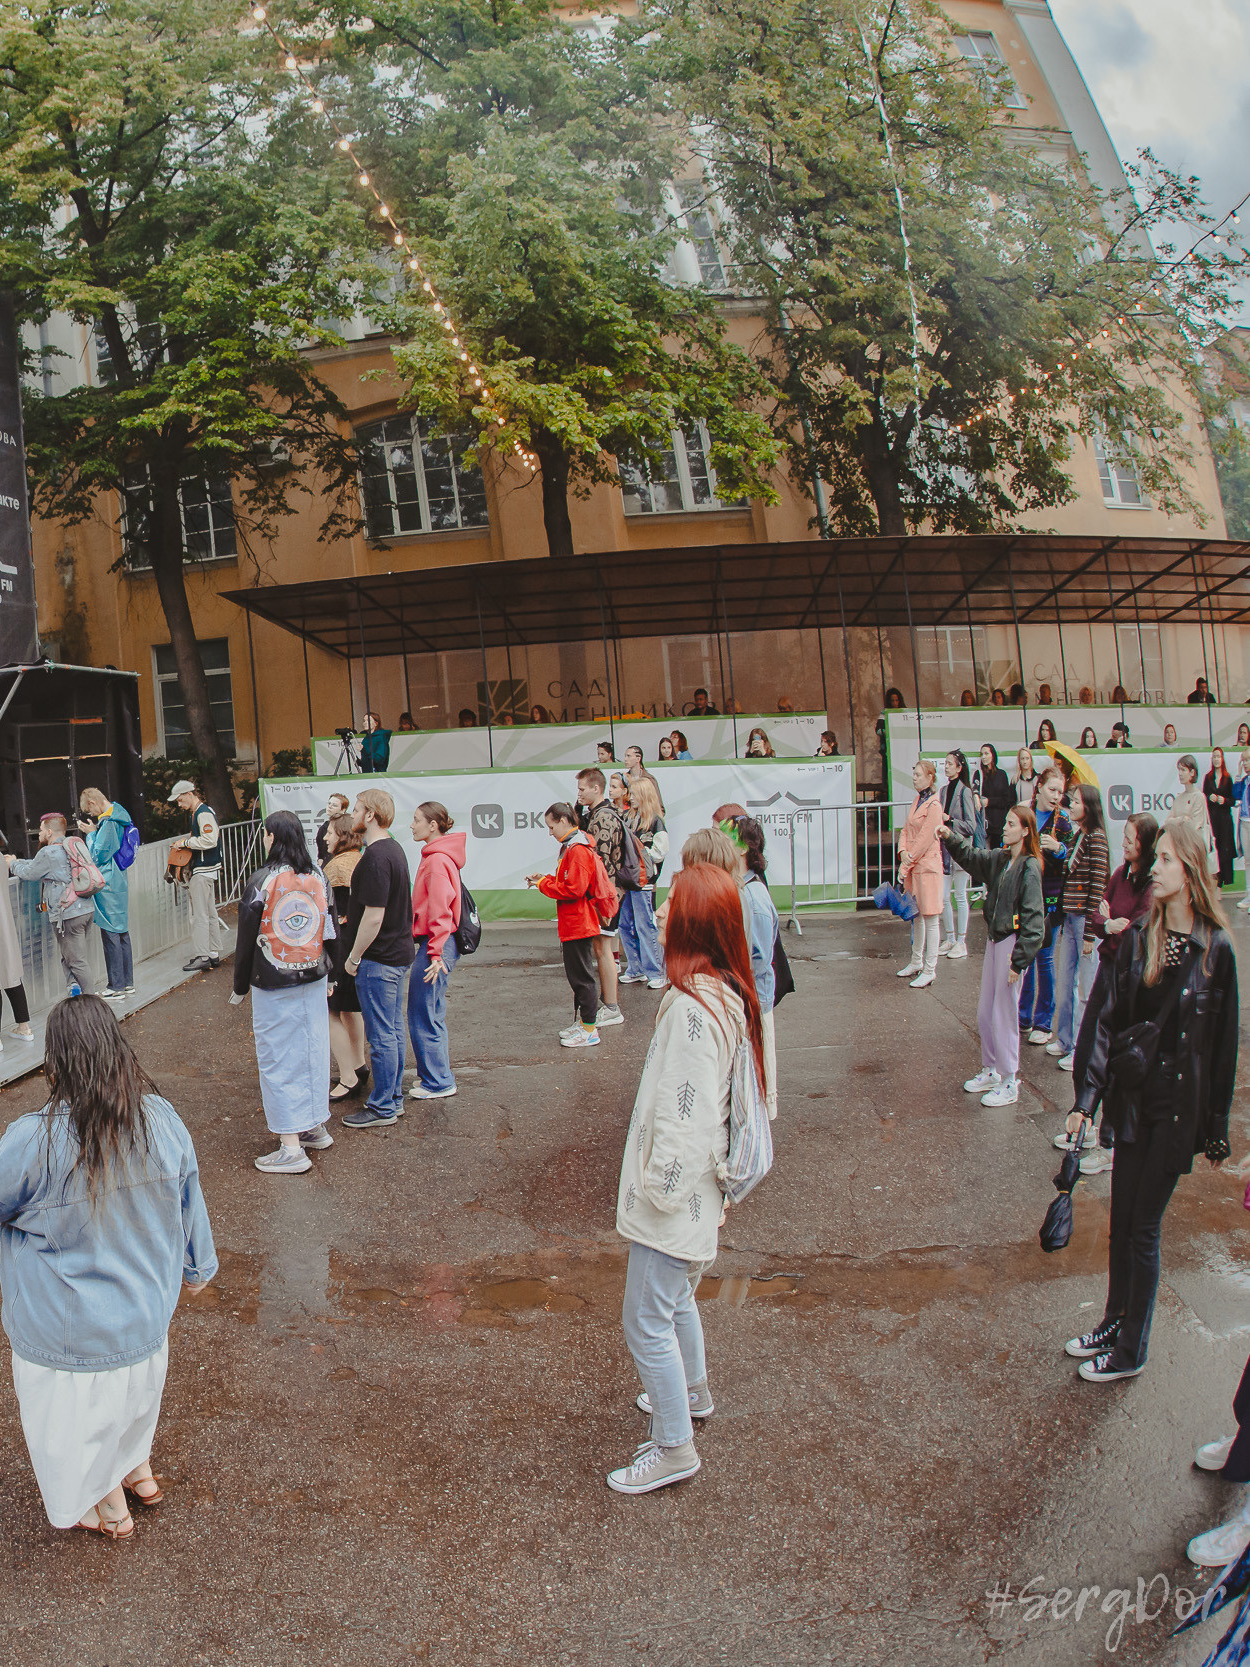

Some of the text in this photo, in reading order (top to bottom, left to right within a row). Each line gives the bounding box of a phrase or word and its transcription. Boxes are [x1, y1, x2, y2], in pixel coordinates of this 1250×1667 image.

[0, 576, 13, 592] FM
[1033, 663, 1080, 681] САД
[547, 679, 606, 699] САД
[797, 813, 813, 823] FM
